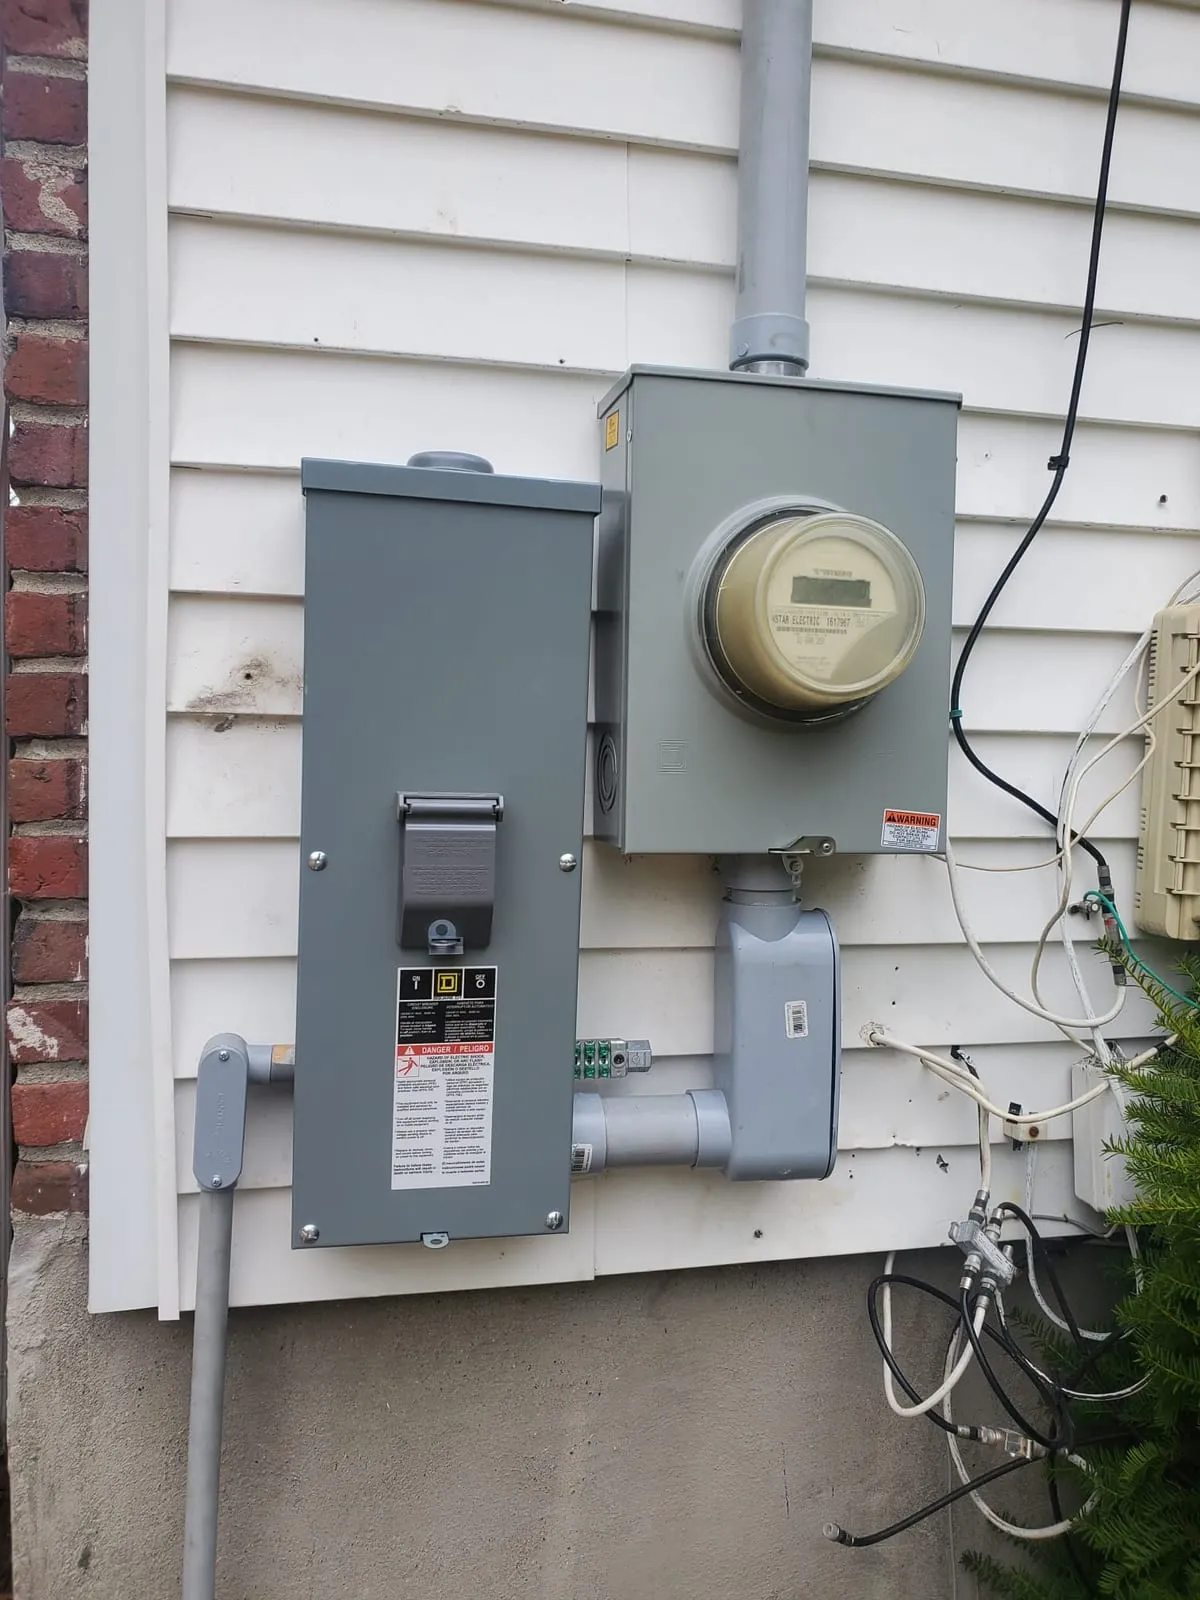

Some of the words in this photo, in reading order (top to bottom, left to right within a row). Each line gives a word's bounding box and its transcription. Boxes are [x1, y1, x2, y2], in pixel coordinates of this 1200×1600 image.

[792, 615, 820, 626] ELECTRIC
[896, 814, 936, 826] WARNING
[421, 1045, 451, 1054] DANGER
[459, 1044, 490, 1053] PELIGRO
